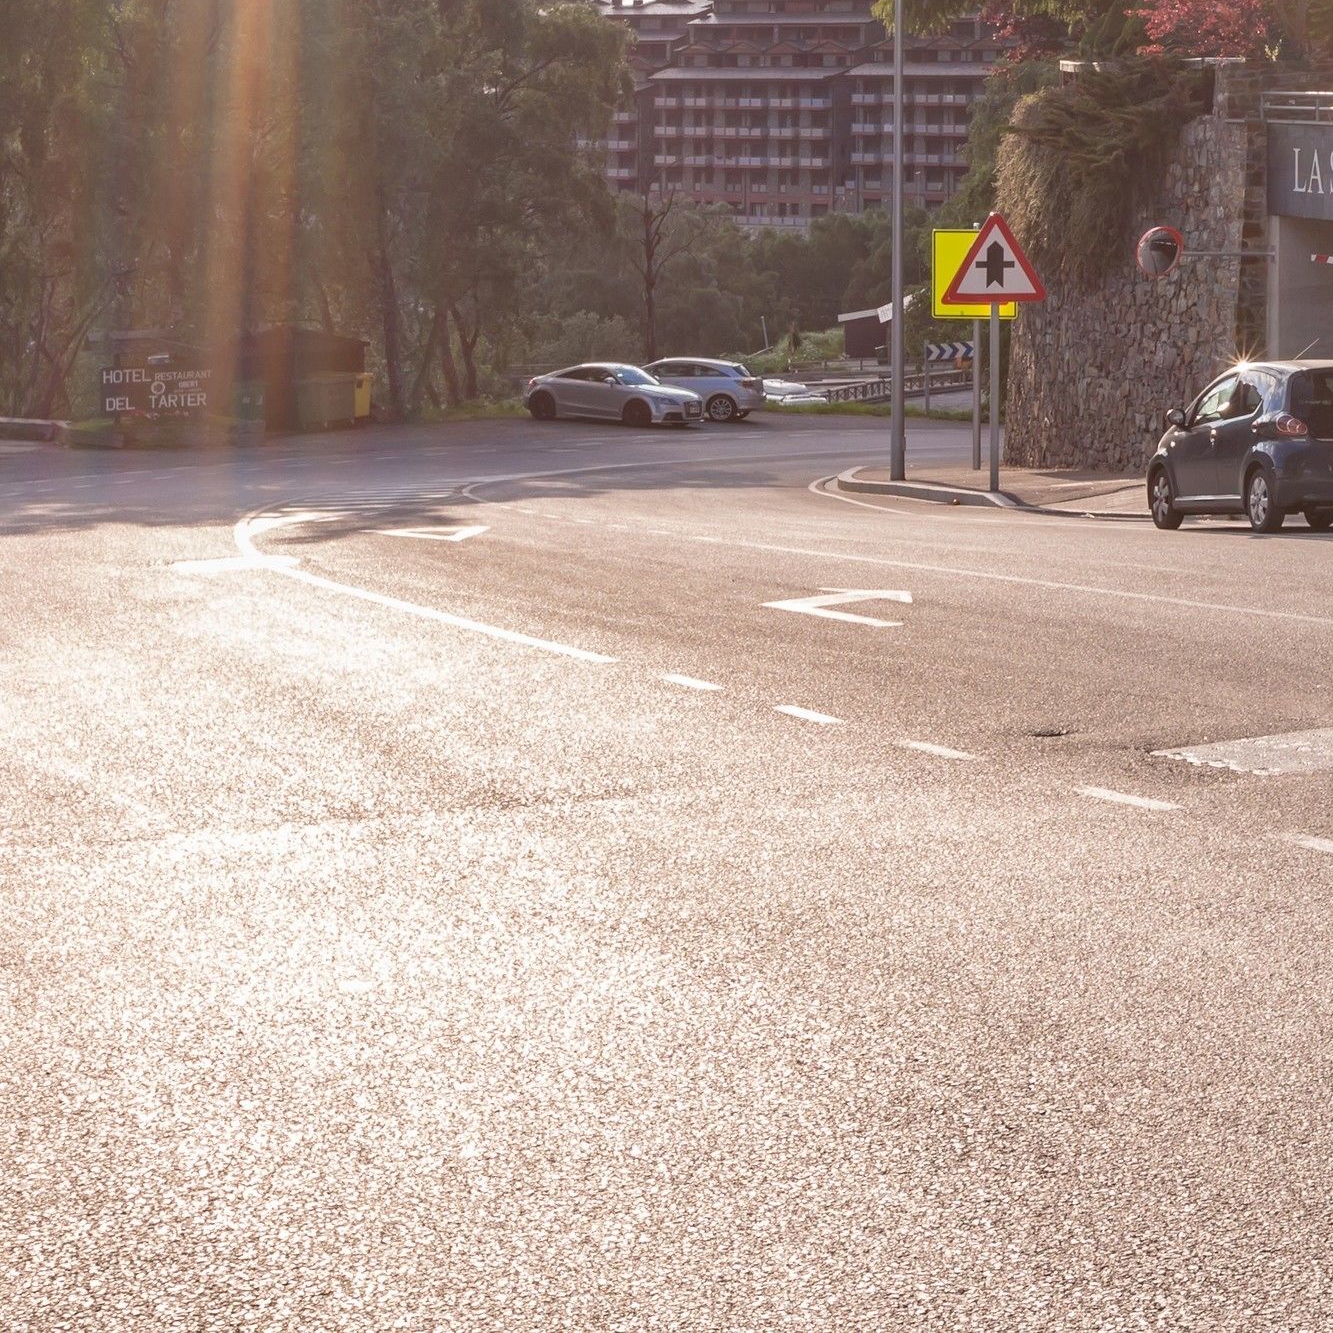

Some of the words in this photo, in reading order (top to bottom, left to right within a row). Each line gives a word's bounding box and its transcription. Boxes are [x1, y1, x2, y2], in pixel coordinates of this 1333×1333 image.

[1293, 147, 1325, 194] LA
[103, 369, 151, 384] HOTEL
[155, 370, 213, 381] RESTAURANT
[106, 397, 136, 411] DEL
[149, 393, 207, 409] TARTER
